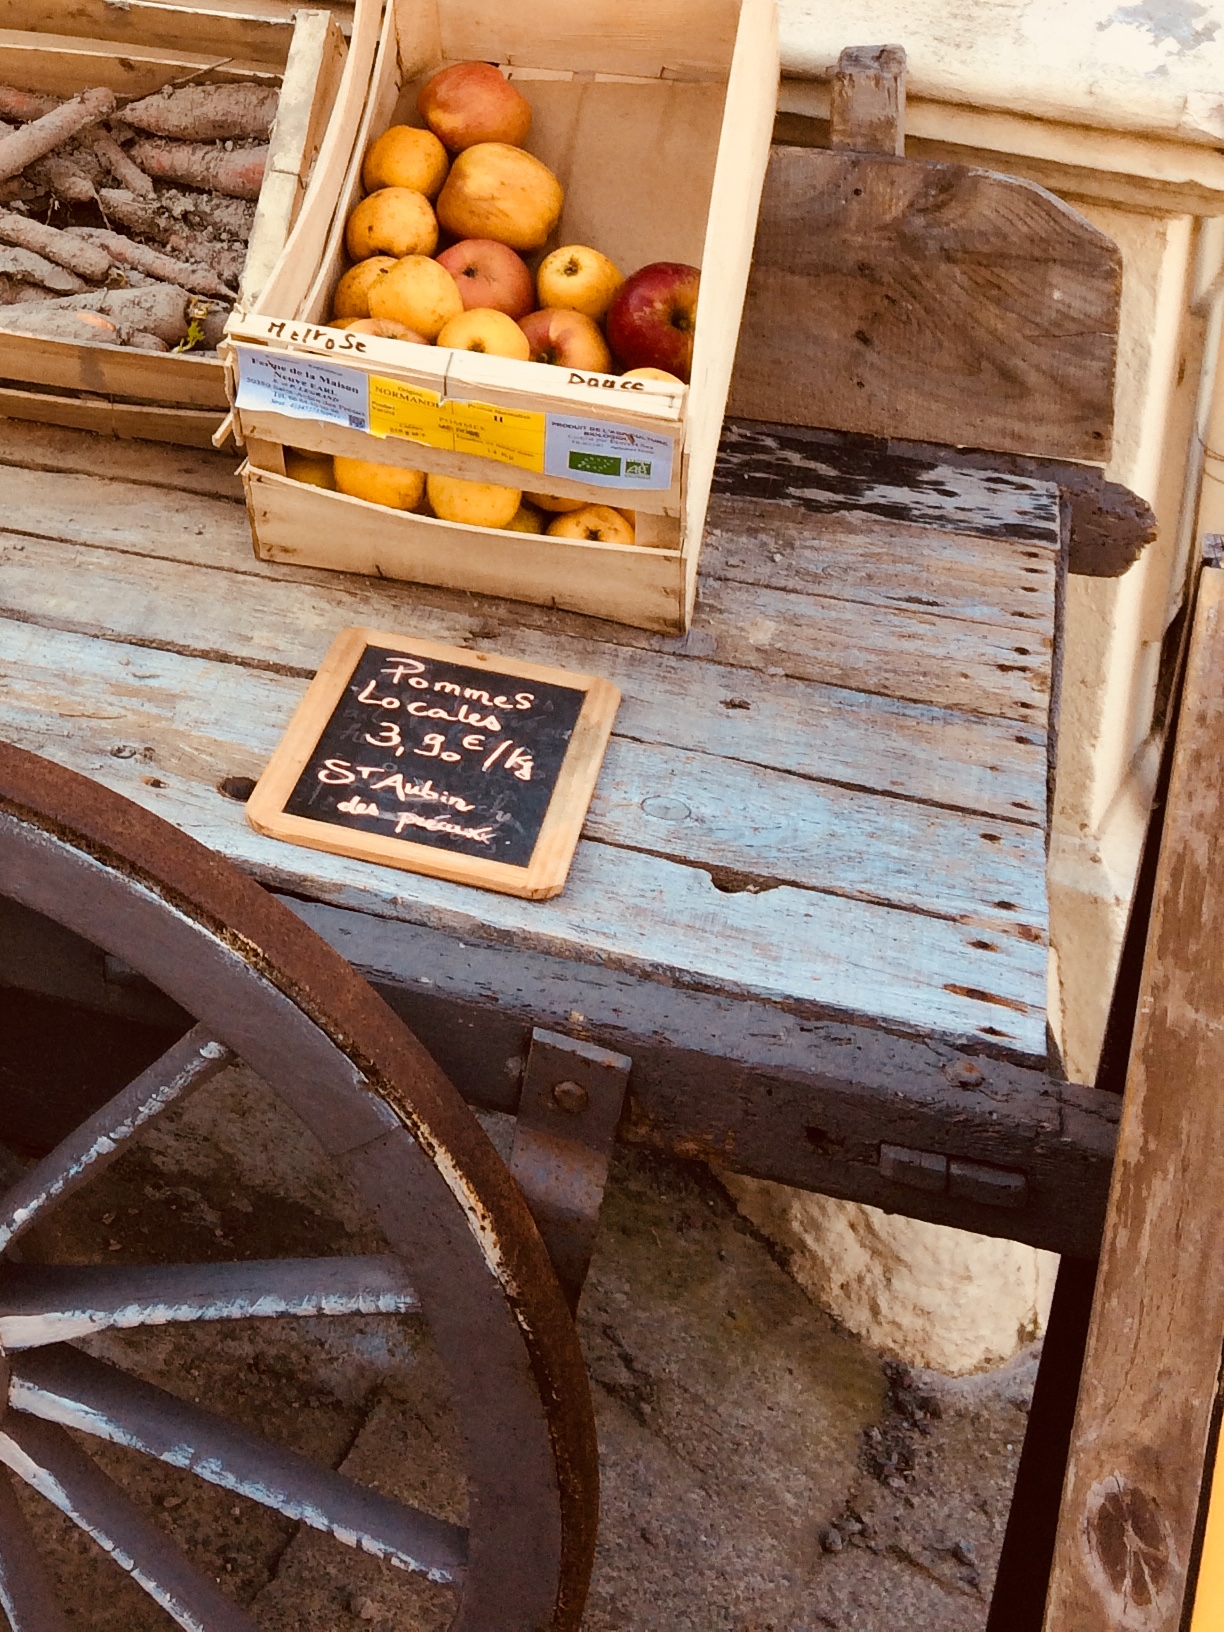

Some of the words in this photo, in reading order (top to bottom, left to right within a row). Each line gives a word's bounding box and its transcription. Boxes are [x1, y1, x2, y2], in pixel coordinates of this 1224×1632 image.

[274, 371, 307, 386] Neuve
[290, 367, 302, 376] de
[305, 371, 316, 380] la
[319, 375, 359, 394] Maison
[357, 679, 502, 732] Locales
[370, 773, 476, 812] Aubin
